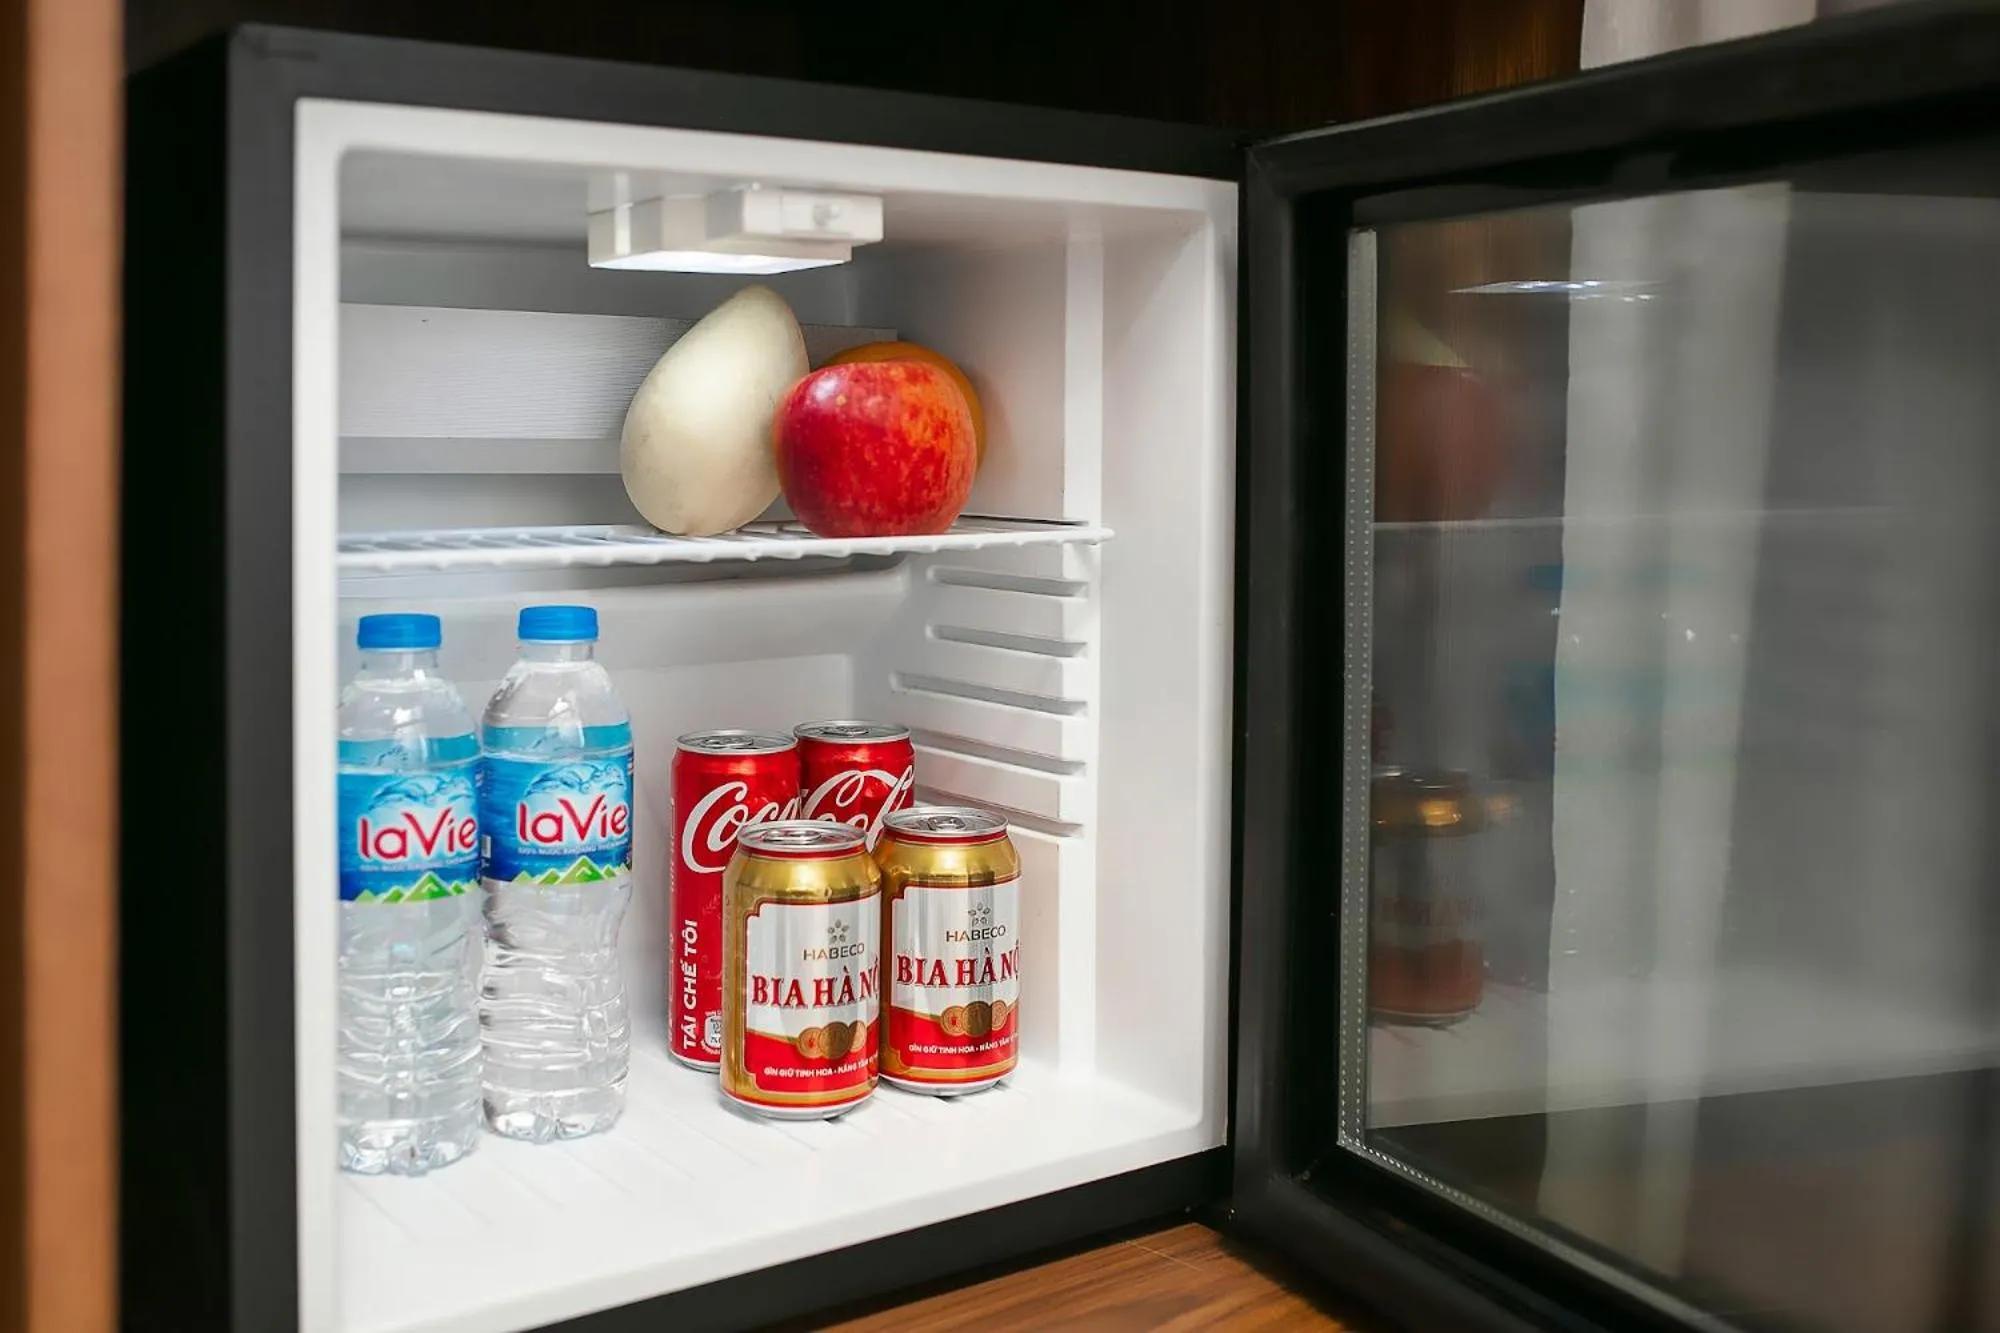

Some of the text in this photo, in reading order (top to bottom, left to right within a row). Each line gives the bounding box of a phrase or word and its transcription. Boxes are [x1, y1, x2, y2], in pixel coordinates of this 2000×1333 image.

[360, 807, 477, 859] laVie
[519, 795, 628, 844] laVie
[803, 943, 864, 960] HABECO
[946, 925, 1005, 941] HABECO
[680, 919, 698, 1049] TÁI CHẾ TÔI
[752, 974, 807, 1009] BIA
[812, 965, 858, 1008] HÀ
[896, 954, 950, 987] BIA
[955, 946, 998, 987] HÀ
